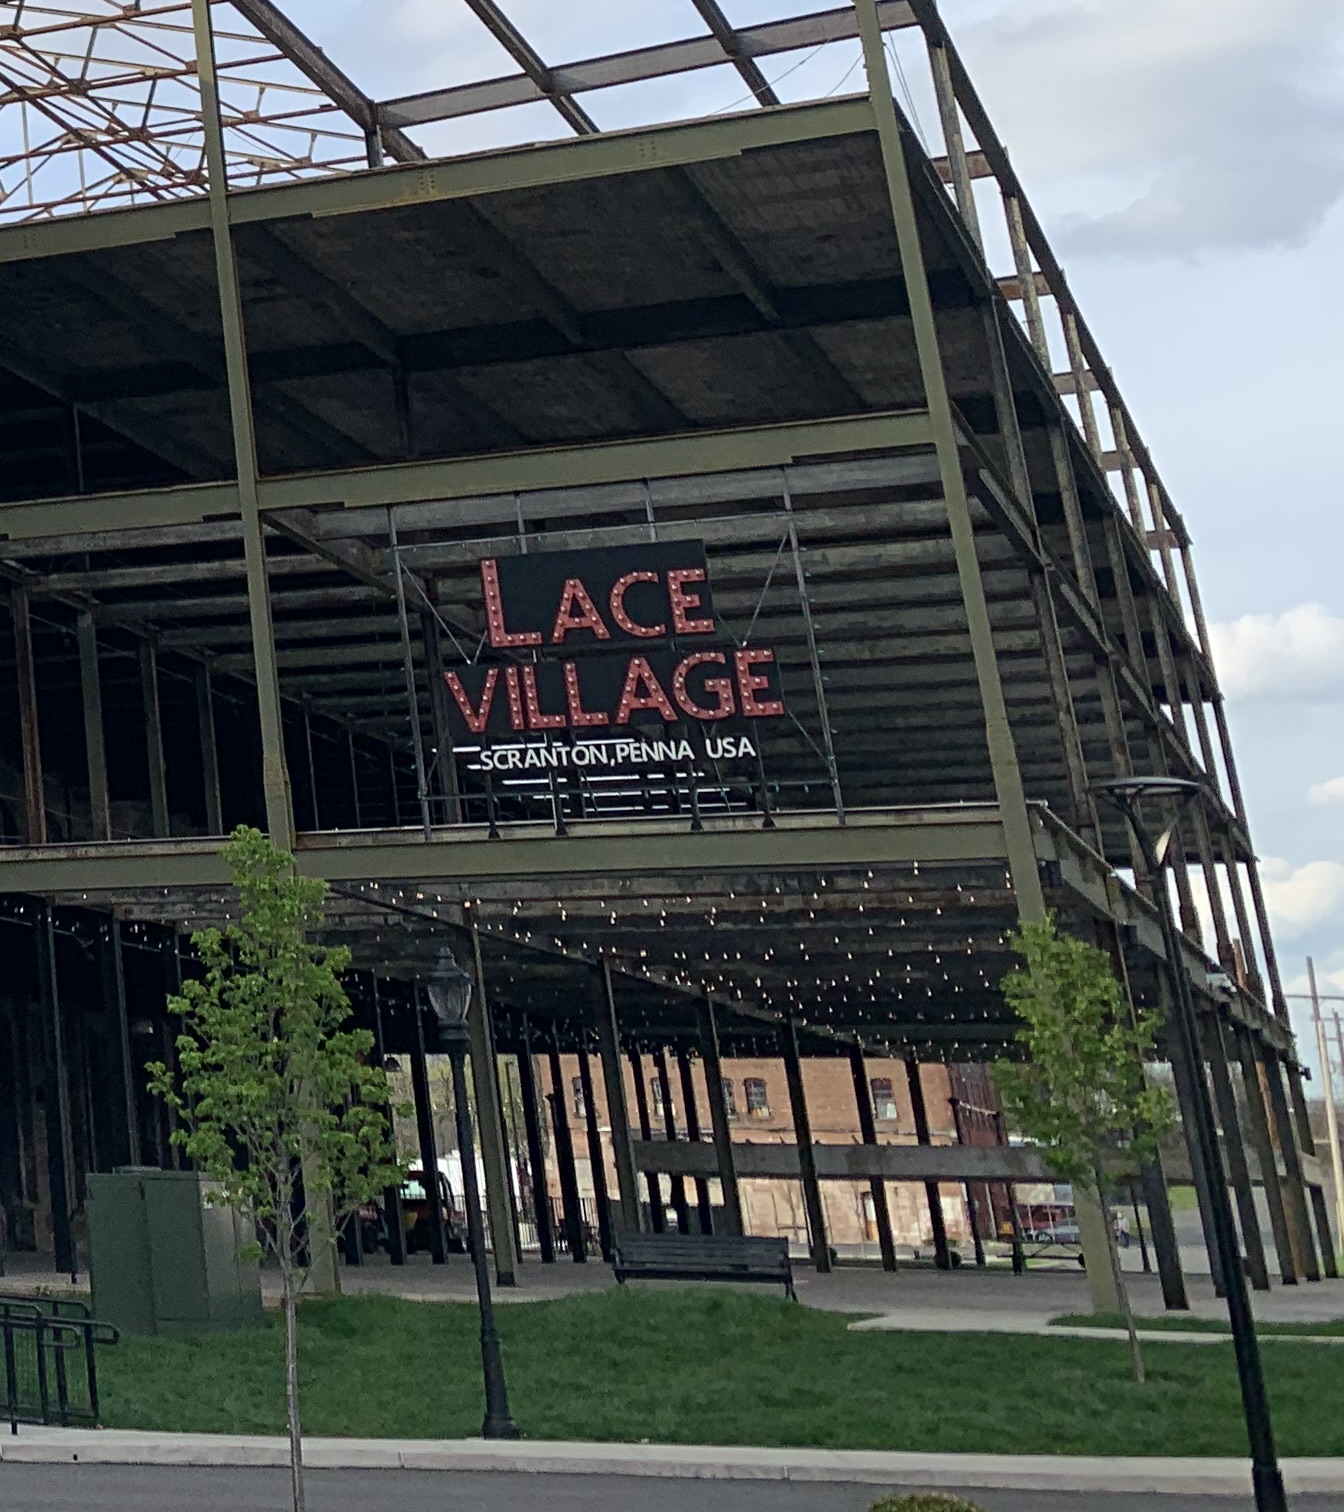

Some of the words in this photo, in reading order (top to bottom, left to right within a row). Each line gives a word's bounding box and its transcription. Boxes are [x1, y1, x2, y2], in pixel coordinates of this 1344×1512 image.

[480, 558, 716, 648] LACE
[443, 647, 786, 734] VILLAGE
[705, 736, 757, 760] USA
